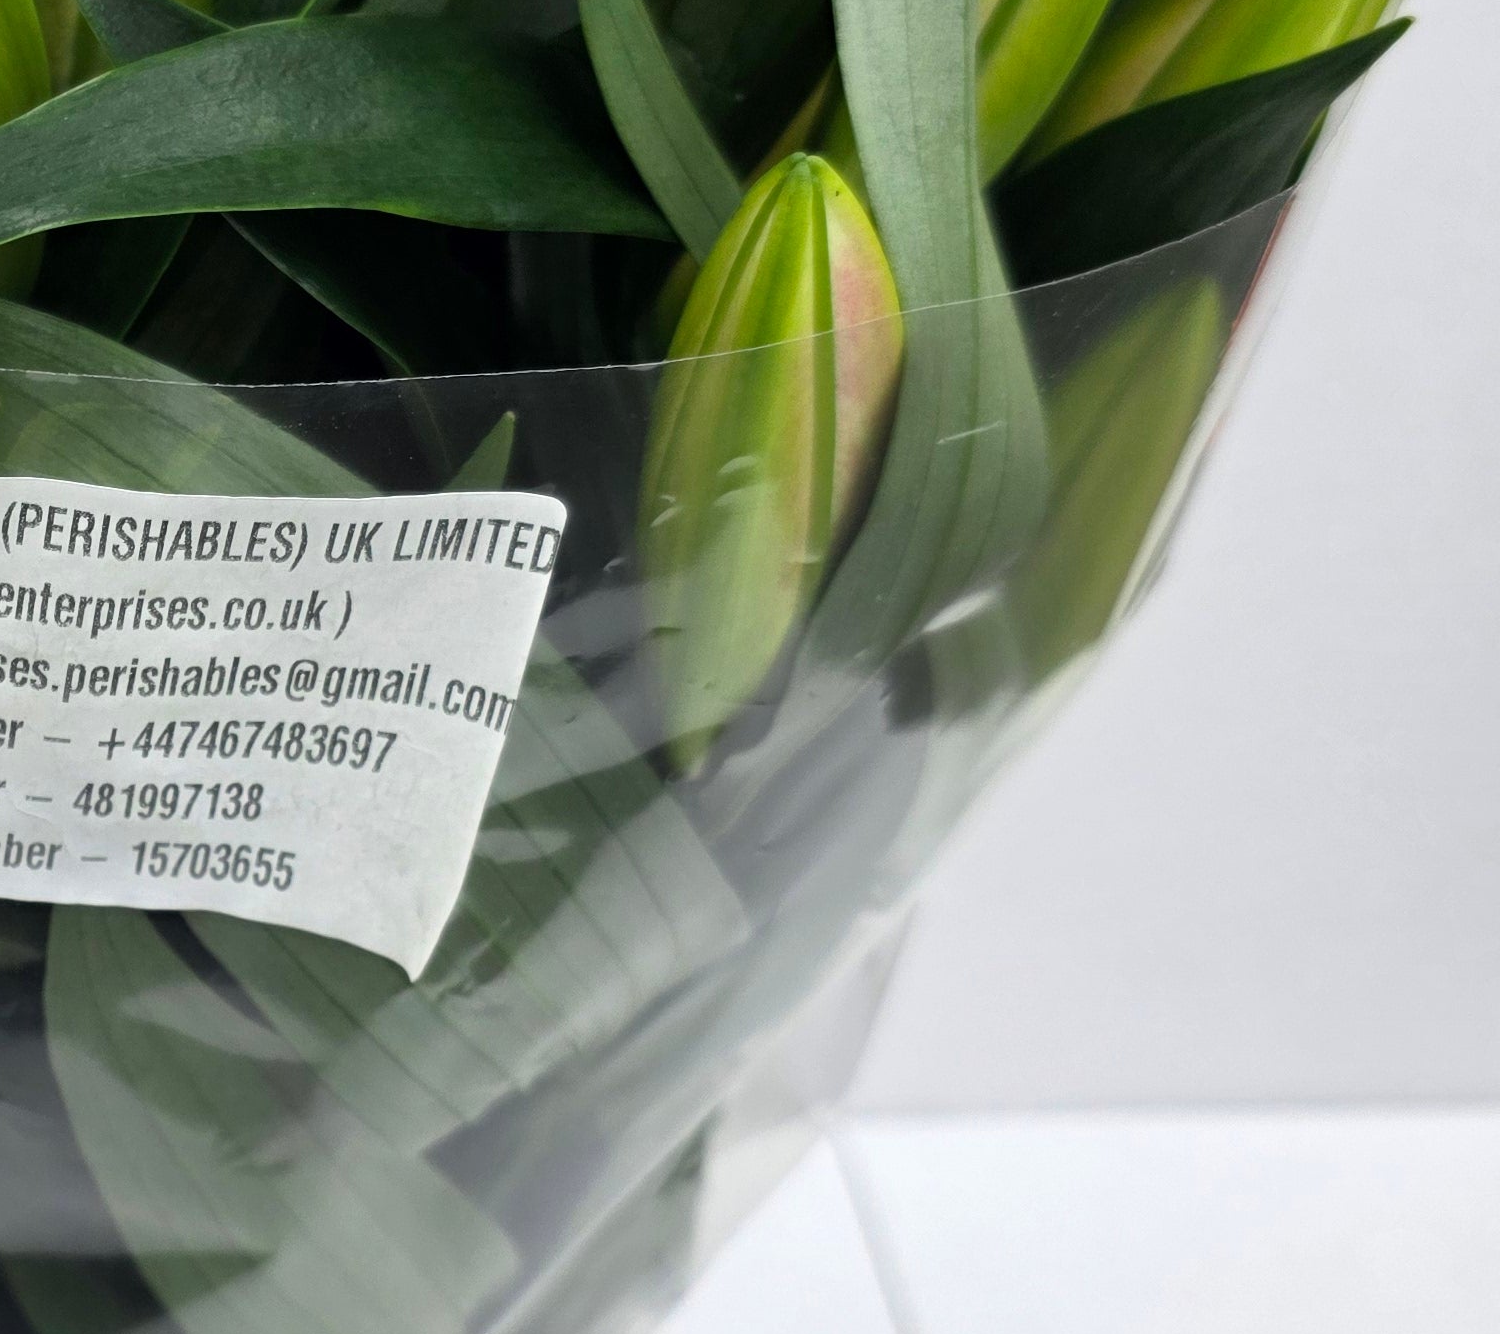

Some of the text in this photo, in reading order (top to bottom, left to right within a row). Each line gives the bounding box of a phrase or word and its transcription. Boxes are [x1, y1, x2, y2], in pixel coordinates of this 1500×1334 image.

[1, 500, 309, 572] (PERISHABLES)
[324, 521, 384, 564] UK
[392, 517, 563, 575] LIMITED
[98, 720, 398, 773] +447467483697
[72, 781, 265, 822] 481997138
[131, 840, 296, 892] 15703655
